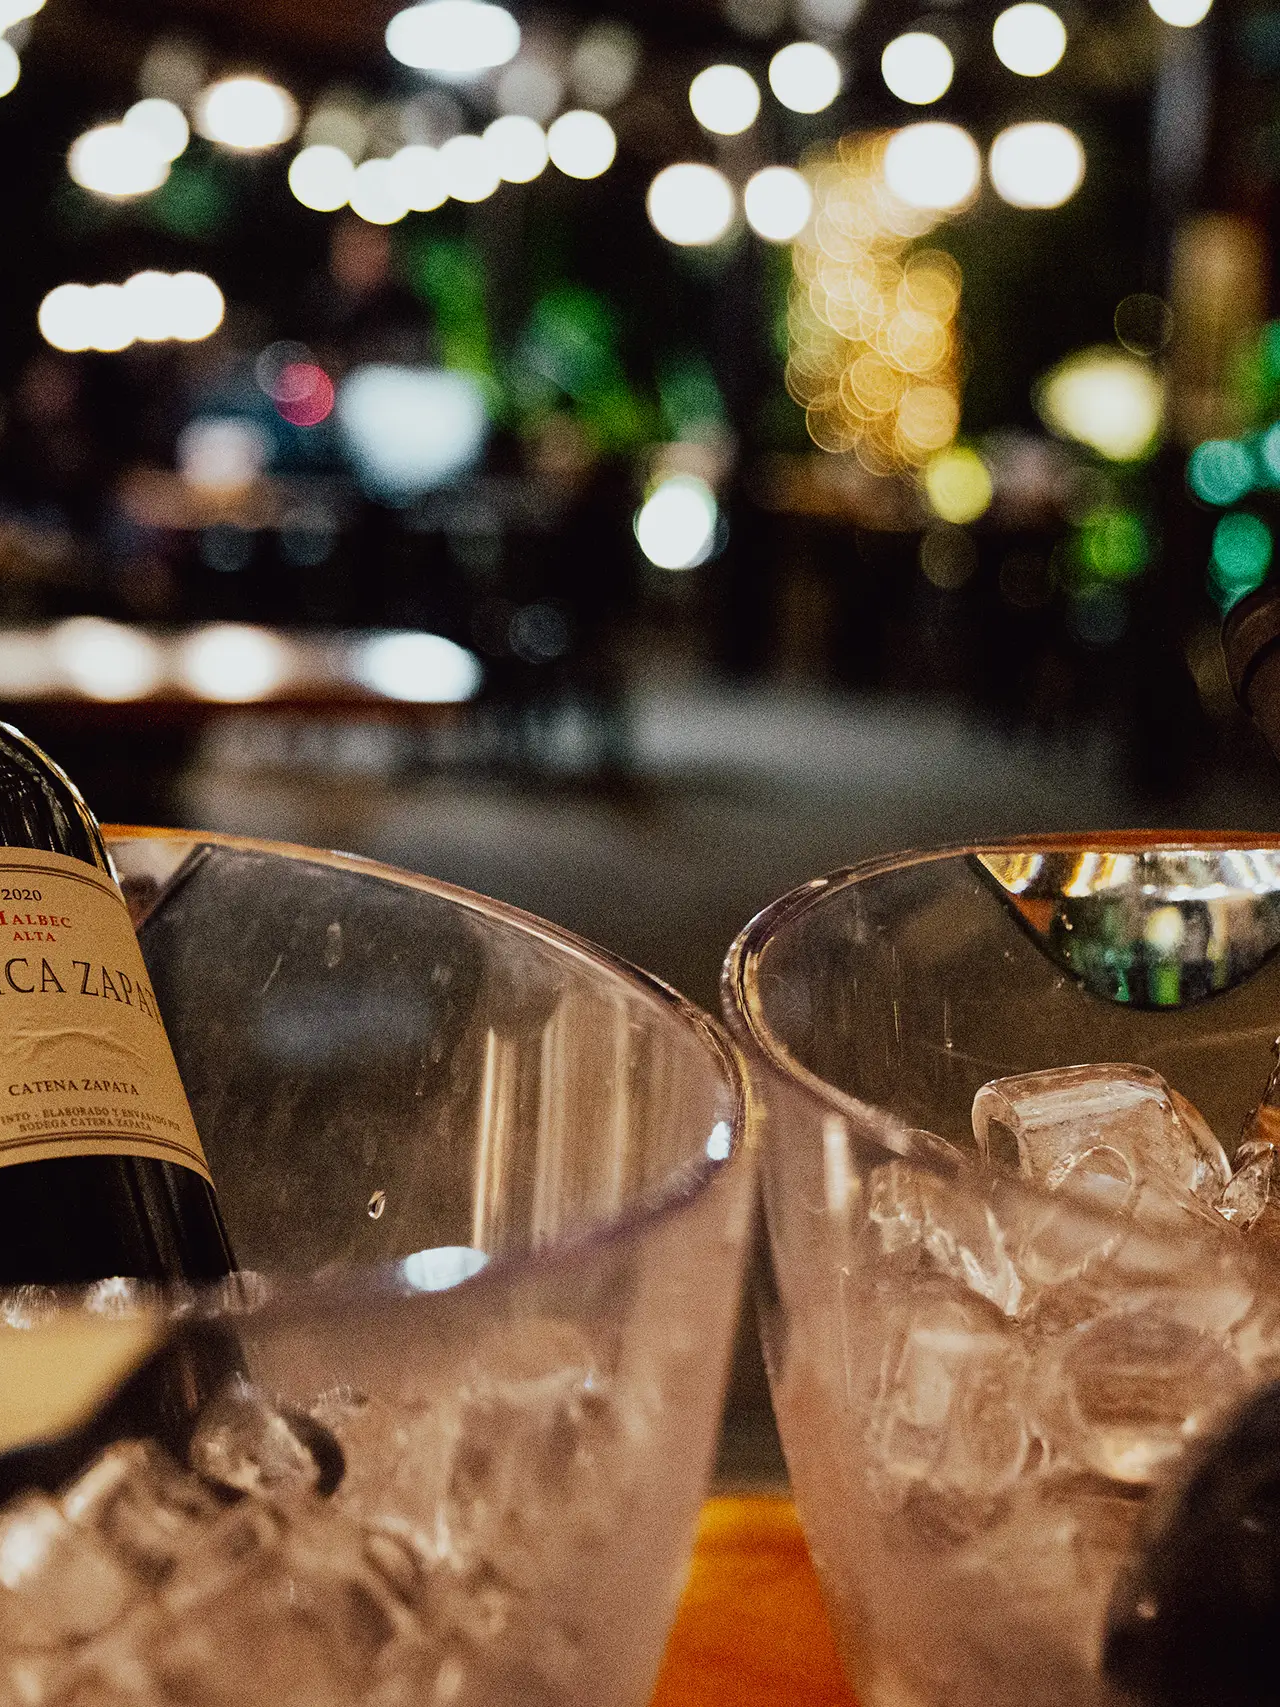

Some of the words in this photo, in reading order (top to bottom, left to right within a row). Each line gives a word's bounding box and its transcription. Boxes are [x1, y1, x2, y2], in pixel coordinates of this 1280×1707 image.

[1, 888, 43, 901] 2020
[12, 931, 57, 942] ALTA
[9, 1080, 79, 1096] CATENA
[81, 1078, 140, 1096] ZAPATA
[42, 1105, 110, 1119] ELABORADO
[19, 1118, 68, 1132] BODEGA
[70, 1118, 115, 1127] CATENA
